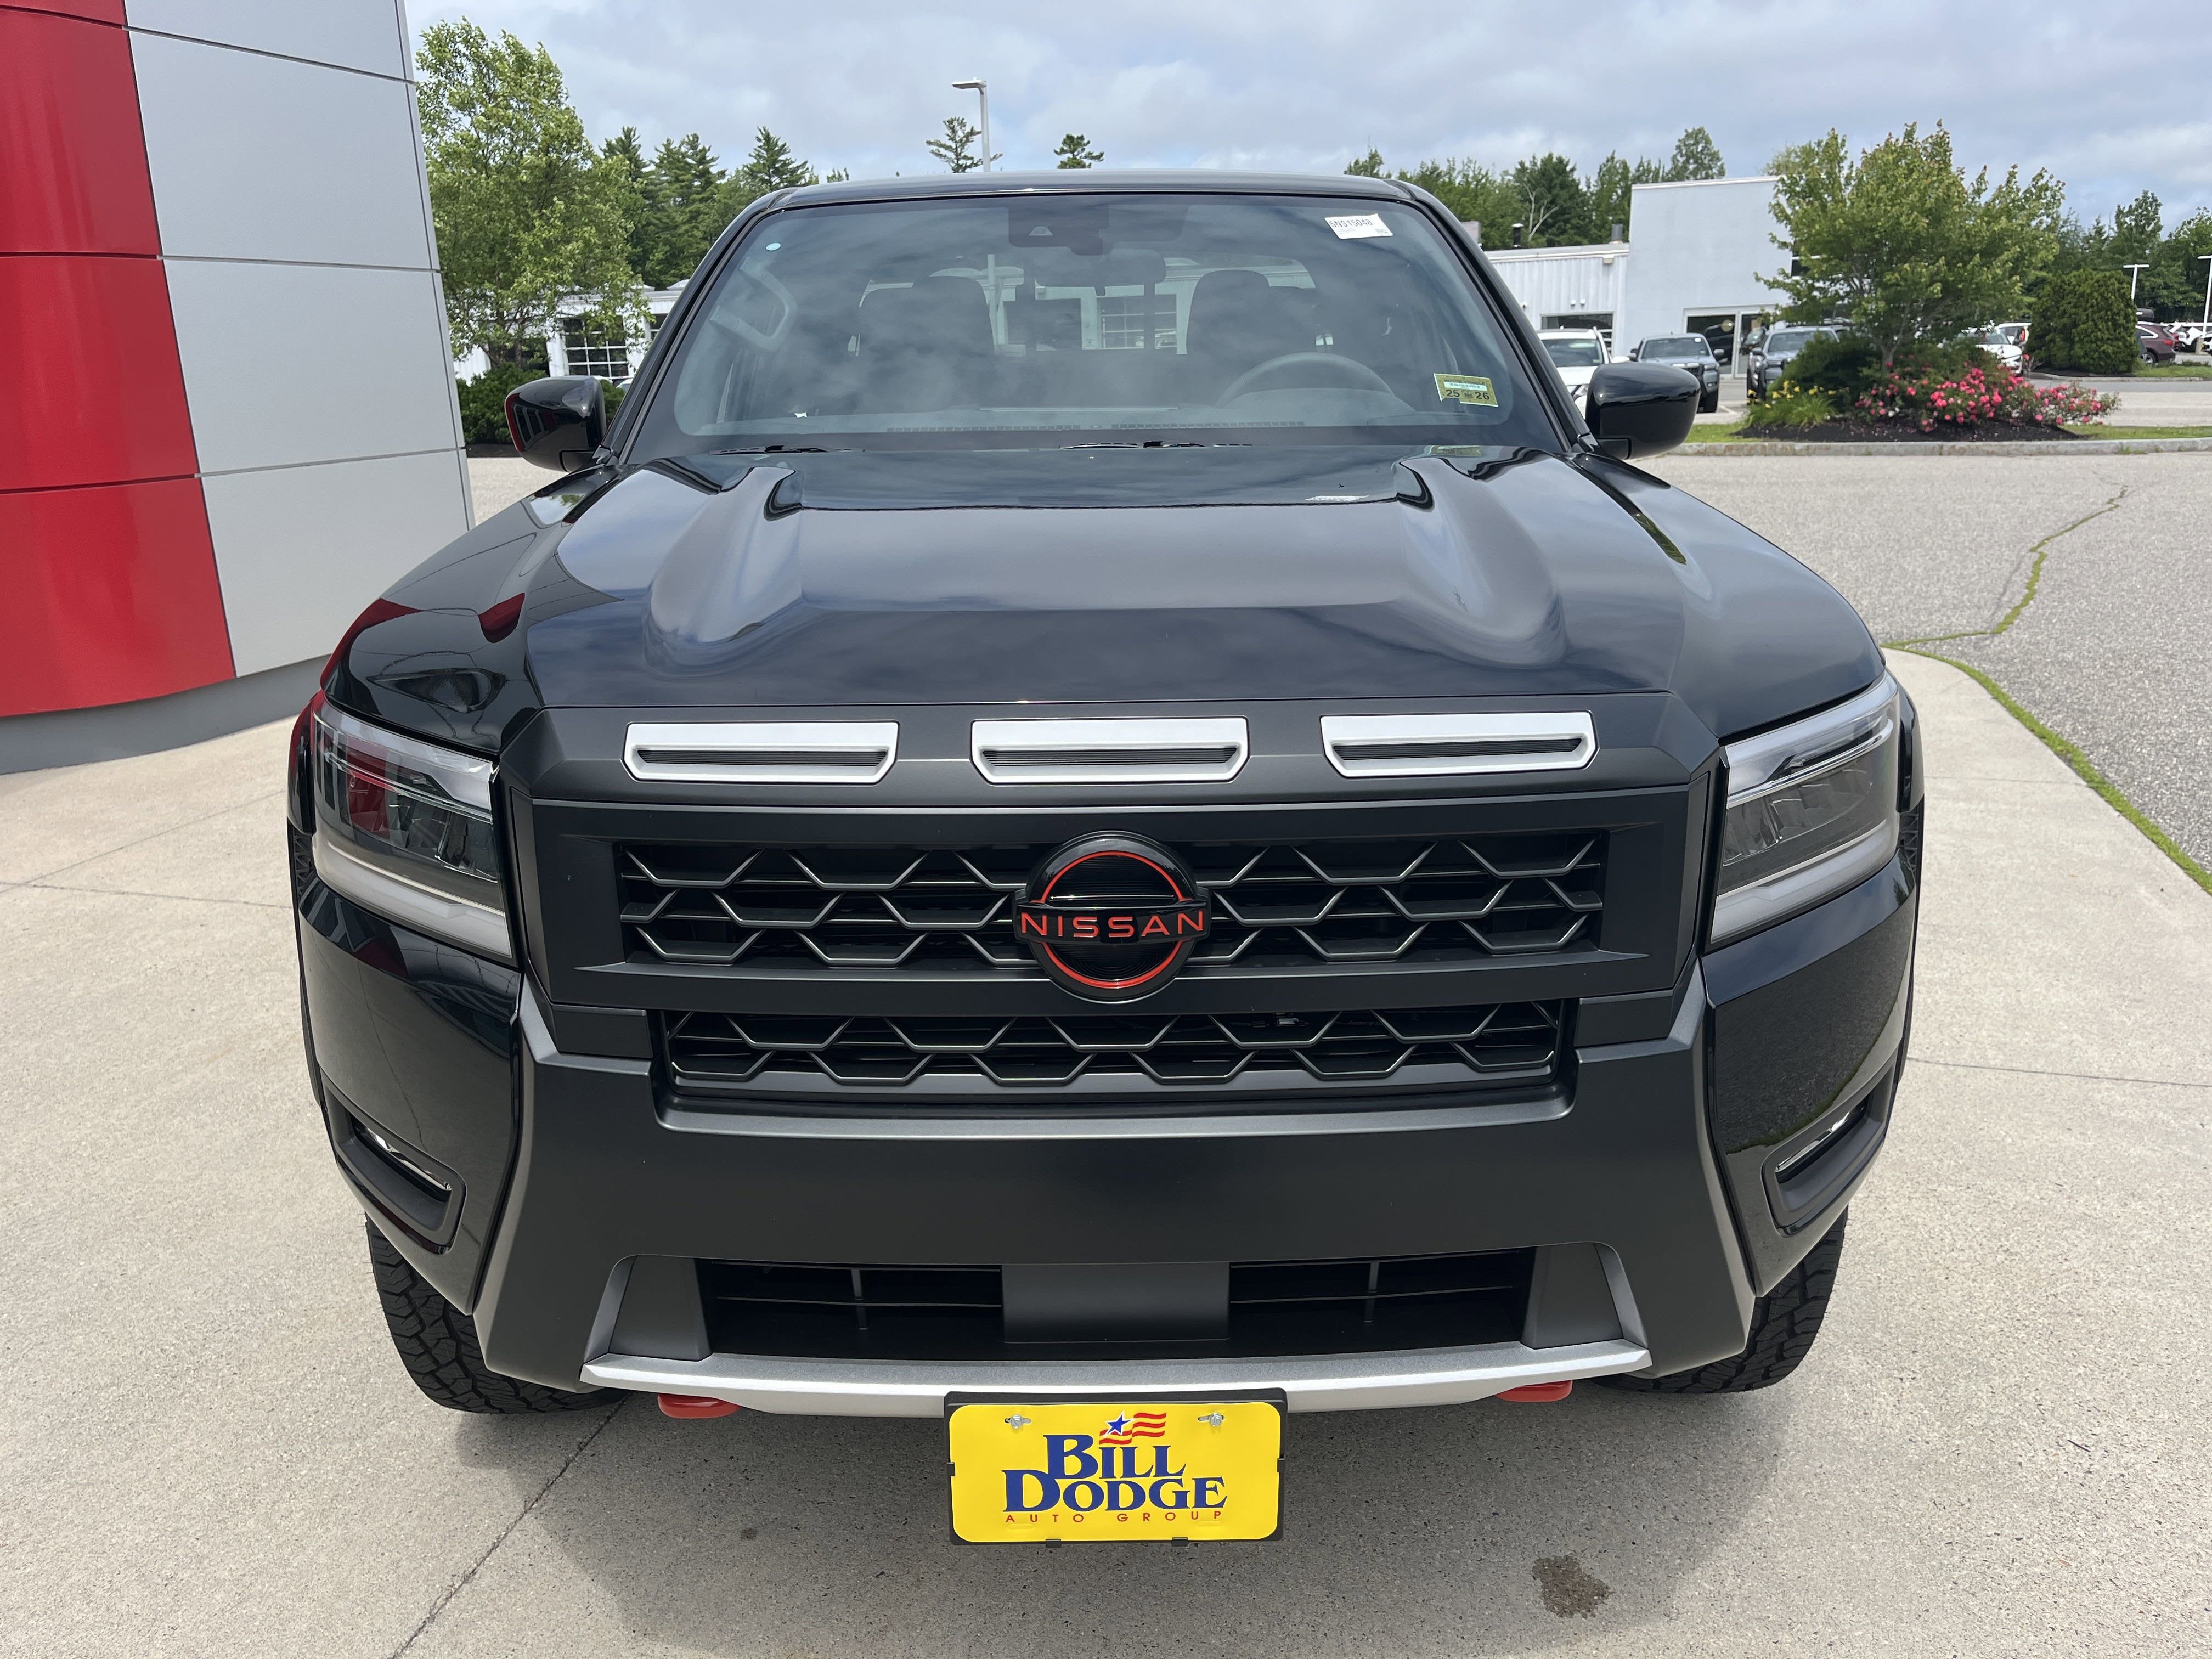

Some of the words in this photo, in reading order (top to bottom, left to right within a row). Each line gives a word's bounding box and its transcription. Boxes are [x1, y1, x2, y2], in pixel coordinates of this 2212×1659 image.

[1446, 389, 1460, 398] 25
[1475, 391, 1489, 400] 26
[1021, 910, 1203, 938] NISSAN
[1043, 1434, 1186, 1479] BILL
[1002, 1469, 1228, 1512] DODGE
[1005, 1514, 1085, 1523] AUTO
[1116, 1510, 1222, 1522] GROUP
